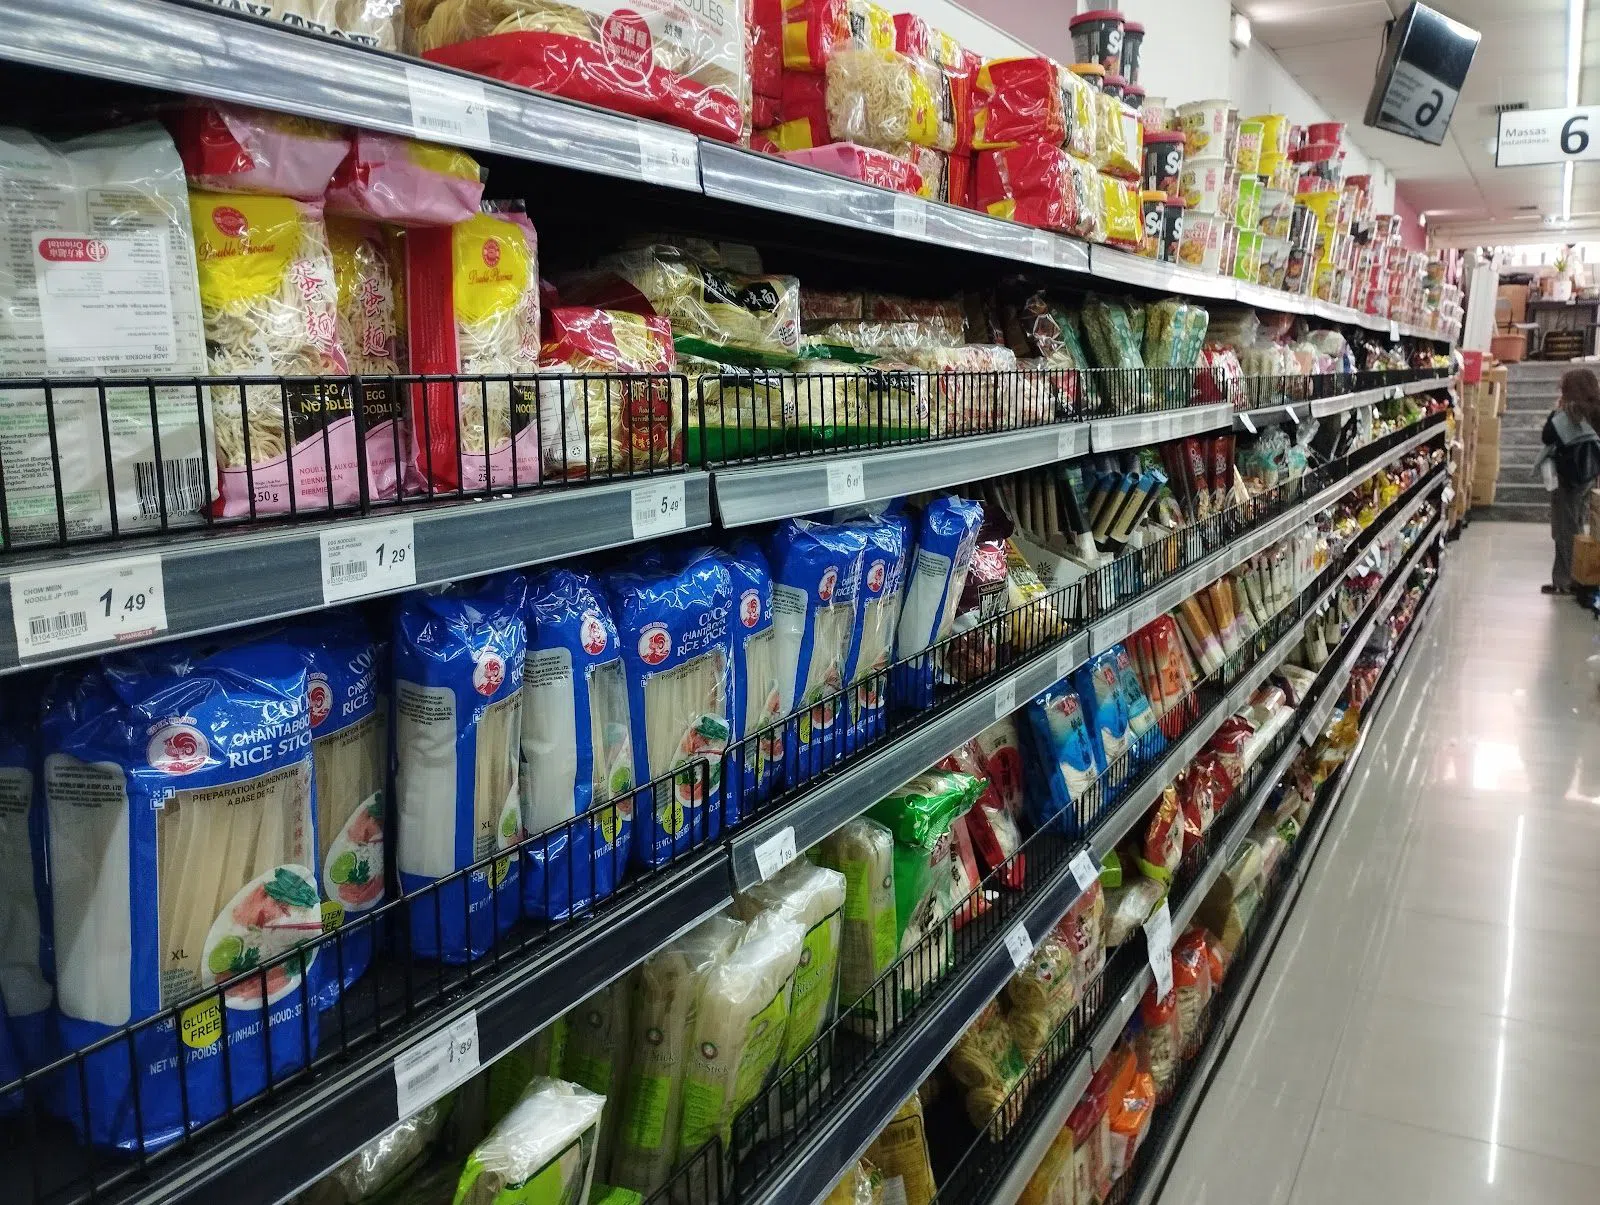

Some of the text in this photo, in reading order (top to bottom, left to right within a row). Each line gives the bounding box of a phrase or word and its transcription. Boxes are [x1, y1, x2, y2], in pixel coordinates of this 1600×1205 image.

[1505, 128, 1547, 138] Massas
[1560, 115, 1590, 155] 6
[47, 240, 84, 249] Oriental
[366, 391, 386, 401] EGG
[23, 586, 45, 596] CHOW
[24, 595, 53, 605] NOODLE
[342, 692, 368, 717] RICE
[228, 743, 273, 769] RICE
[192, 768, 300, 803] PREPARATION ALIMENTAIRE
[227, 799, 234, 807] A
[234, 794, 256, 805] BASE
[256, 791, 265, 799] DE
[171, 948, 188, 961] XL
[183, 1004, 221, 1031] GLUTEN
[190, 1017, 222, 1043] FREE
[150, 1057, 168, 1076] NET
[191, 1043, 218, 1063] POIDS
